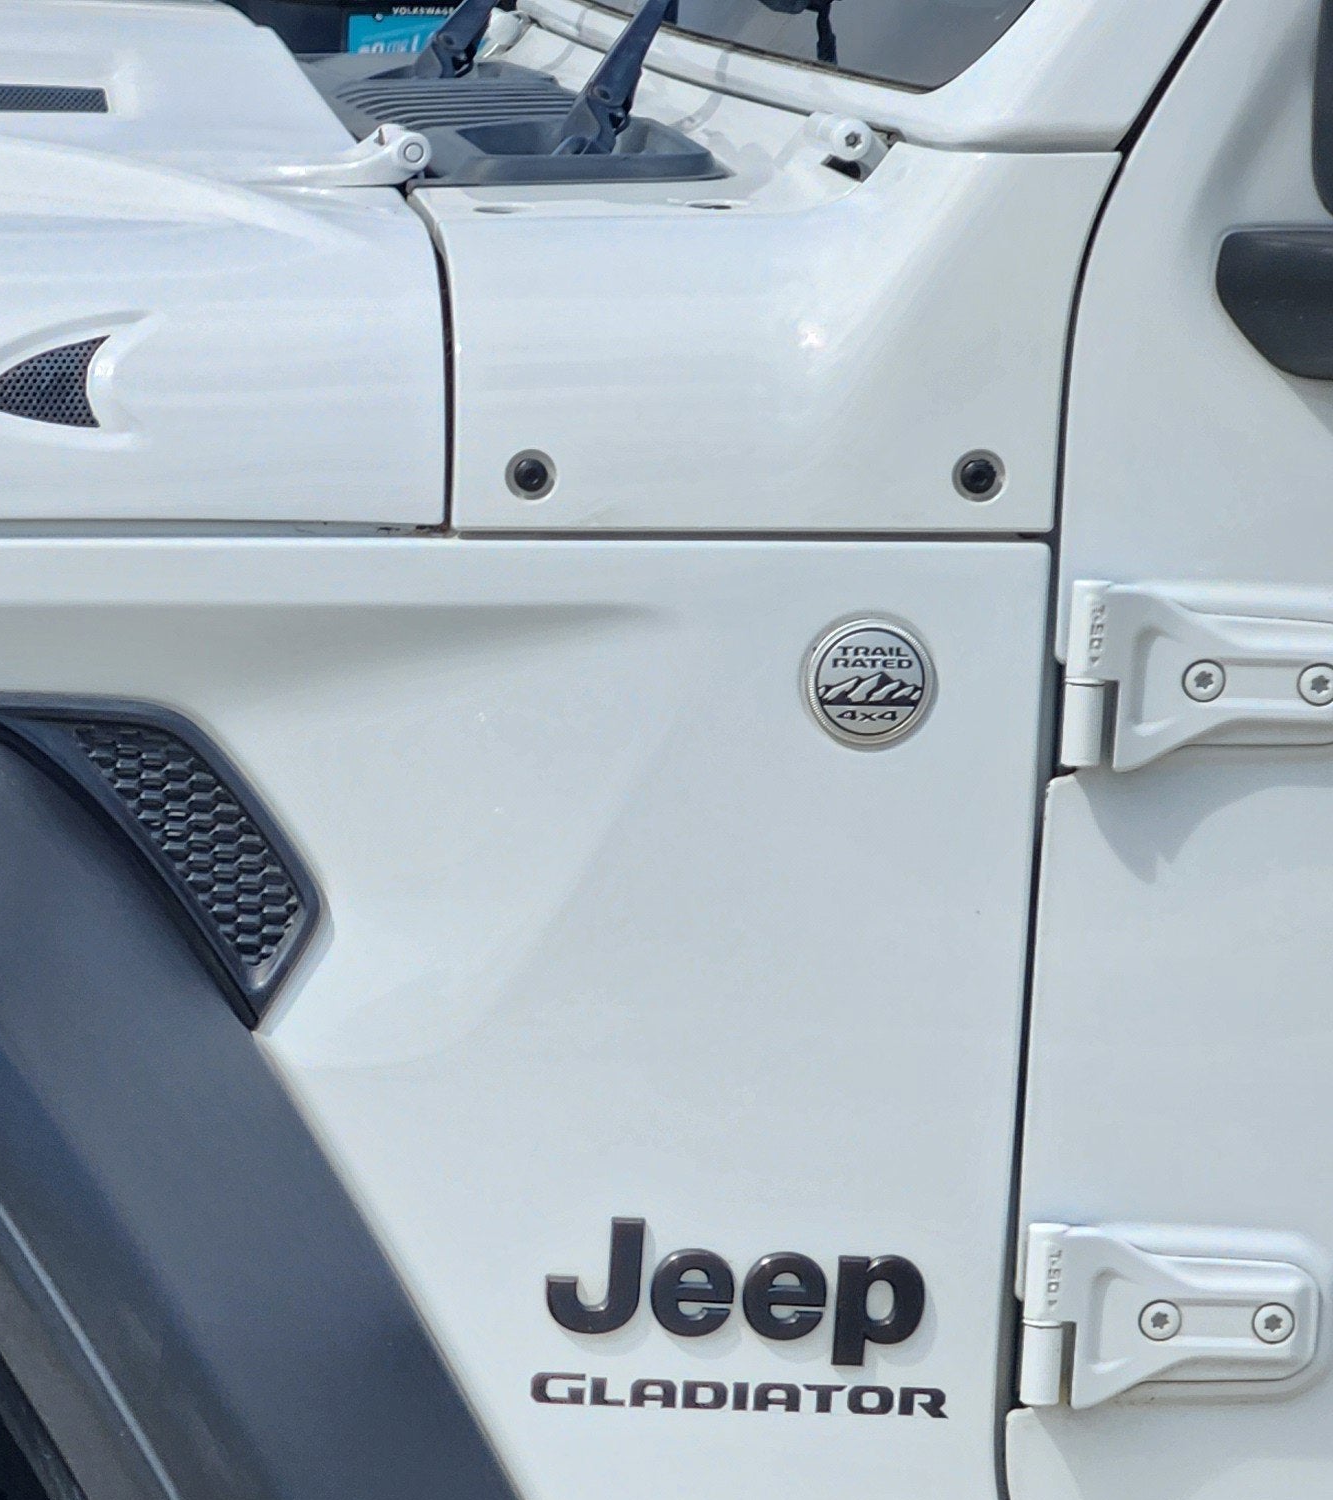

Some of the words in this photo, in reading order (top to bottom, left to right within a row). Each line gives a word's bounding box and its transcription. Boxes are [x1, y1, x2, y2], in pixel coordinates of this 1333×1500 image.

[392, 6, 454, 15] VOLKSWAGE
[837, 645, 909, 657] TRAIL
[832, 658, 913, 669] RATED
[836, 709, 898, 721] 4x4
[545, 1216, 925, 1366] Jeep
[530, 1371, 949, 1419] GLADIATOR
